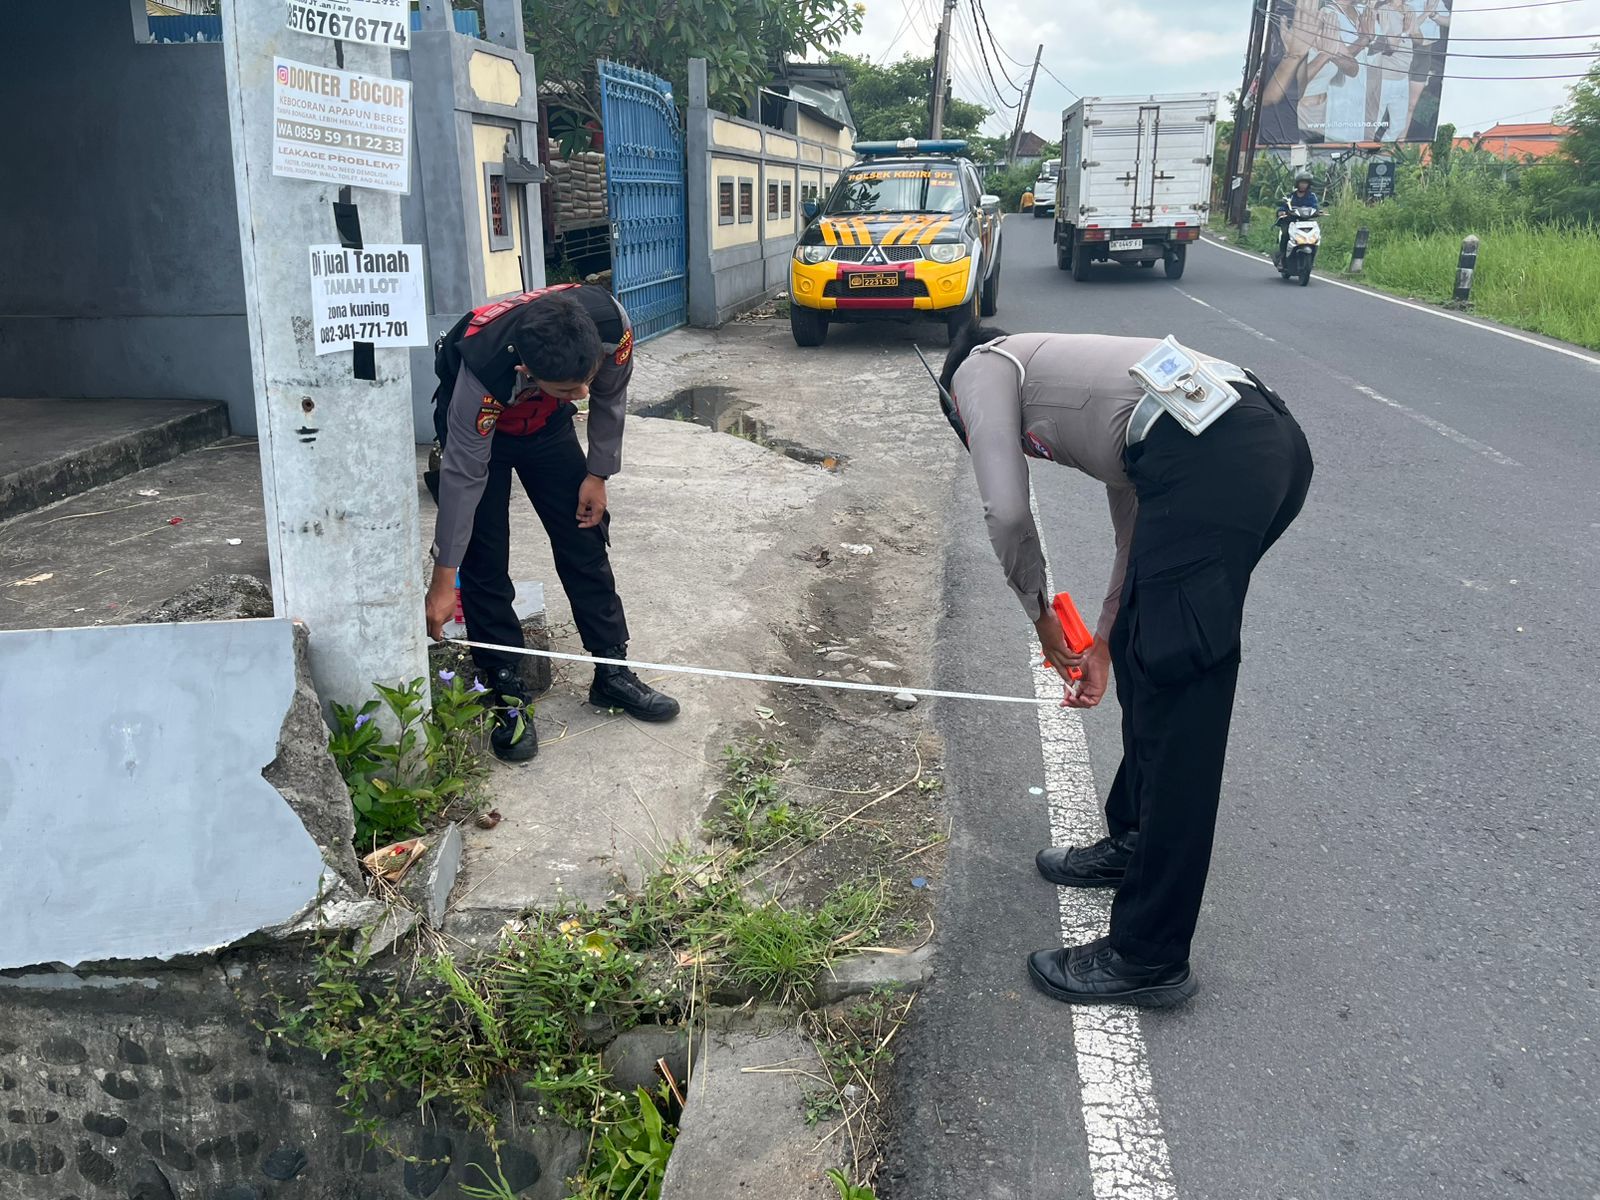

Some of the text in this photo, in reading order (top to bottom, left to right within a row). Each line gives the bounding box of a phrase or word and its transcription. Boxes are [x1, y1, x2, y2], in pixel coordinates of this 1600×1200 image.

[279, 95, 404, 125] KEBOCORAN APAPUN BERES
[277, 121, 402, 153] WA 0859 59 11 22 33
[278, 145, 400, 170] LEAKAGE PROBLEM?
[893, 169, 932, 179] KEDIRI
[934, 171, 954, 179] 901
[353, 250, 410, 273] Tanah
[324, 278, 399, 295] TANAH LOT
[327, 301, 390, 320] zona kuning
[320, 321, 409, 344] 082-341-771-701
